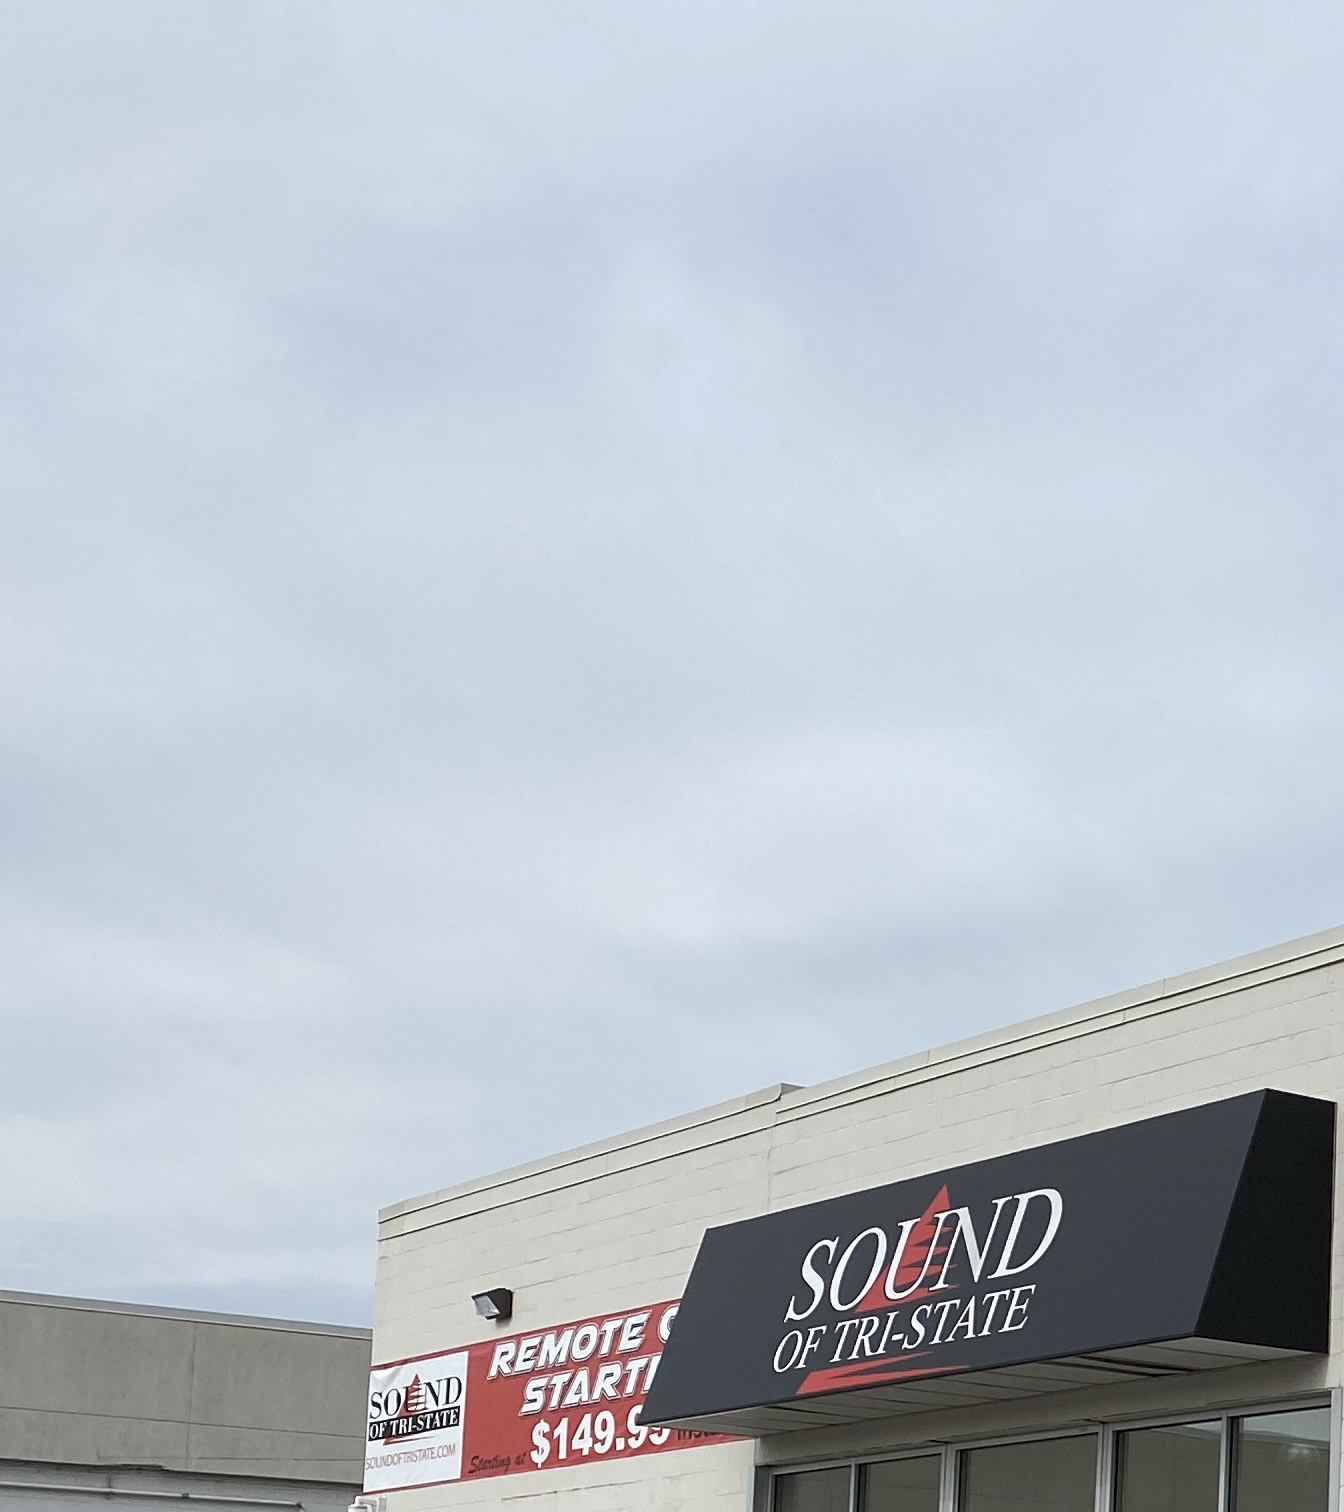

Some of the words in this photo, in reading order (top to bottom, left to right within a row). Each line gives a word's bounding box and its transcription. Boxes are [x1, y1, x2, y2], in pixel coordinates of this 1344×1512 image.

[783, 1188, 1063, 1323] SOUND
[487, 1309, 652, 1380] REMOTE
[772, 1324, 827, 1373] OF
[829, 1284, 1036, 1363] TRI-STATE
[369, 1376, 462, 1419] SOUND
[369, 1421, 387, 1440] OF
[390, 1408, 458, 1436] TRI-STATE
[365, 1443, 456, 1470] SOUNDOFTRISTATE.COM
